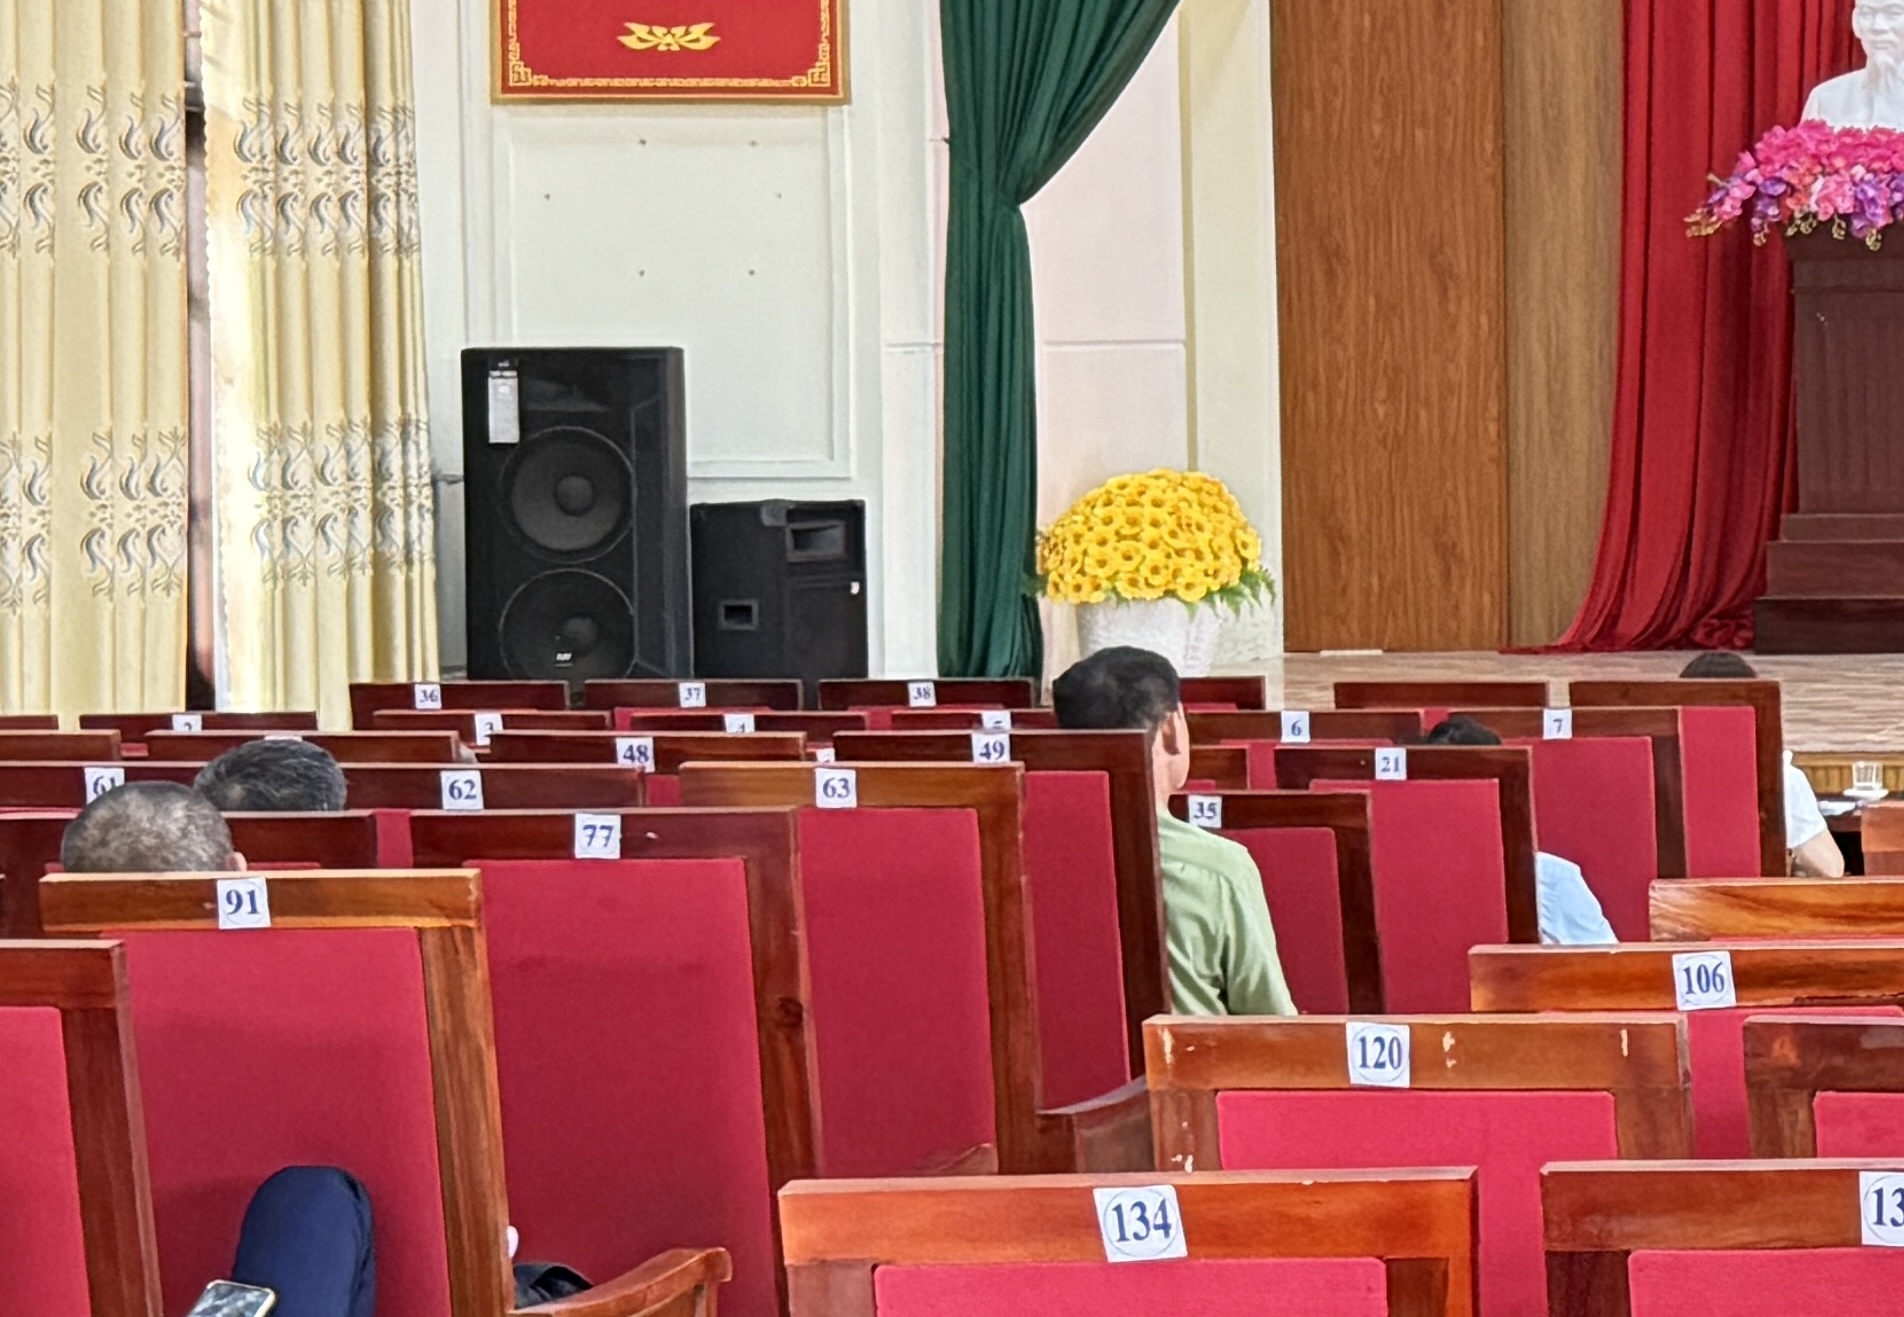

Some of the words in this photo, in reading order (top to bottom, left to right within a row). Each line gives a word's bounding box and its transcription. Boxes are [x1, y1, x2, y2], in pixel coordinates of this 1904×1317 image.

[421, 690, 438, 702] 36
[685, 688, 700, 700] 37
[1291, 721, 1301, 736] 6
[1553, 718, 1563, 733] 7
[623, 745, 649, 763] 48
[979, 742, 1004, 759] 49
[1381, 756, 1399, 772] 21
[449, 780, 476, 799] 62
[823, 778, 850, 797] 63
[1194, 802, 1216, 819] 35
[583, 825, 613, 847] 77
[226, 890, 258, 914] 91
[1684, 962, 1724, 994] 106
[1360, 1036, 1402, 1069] 120
[1113, 1199, 1171, 1242] 134
